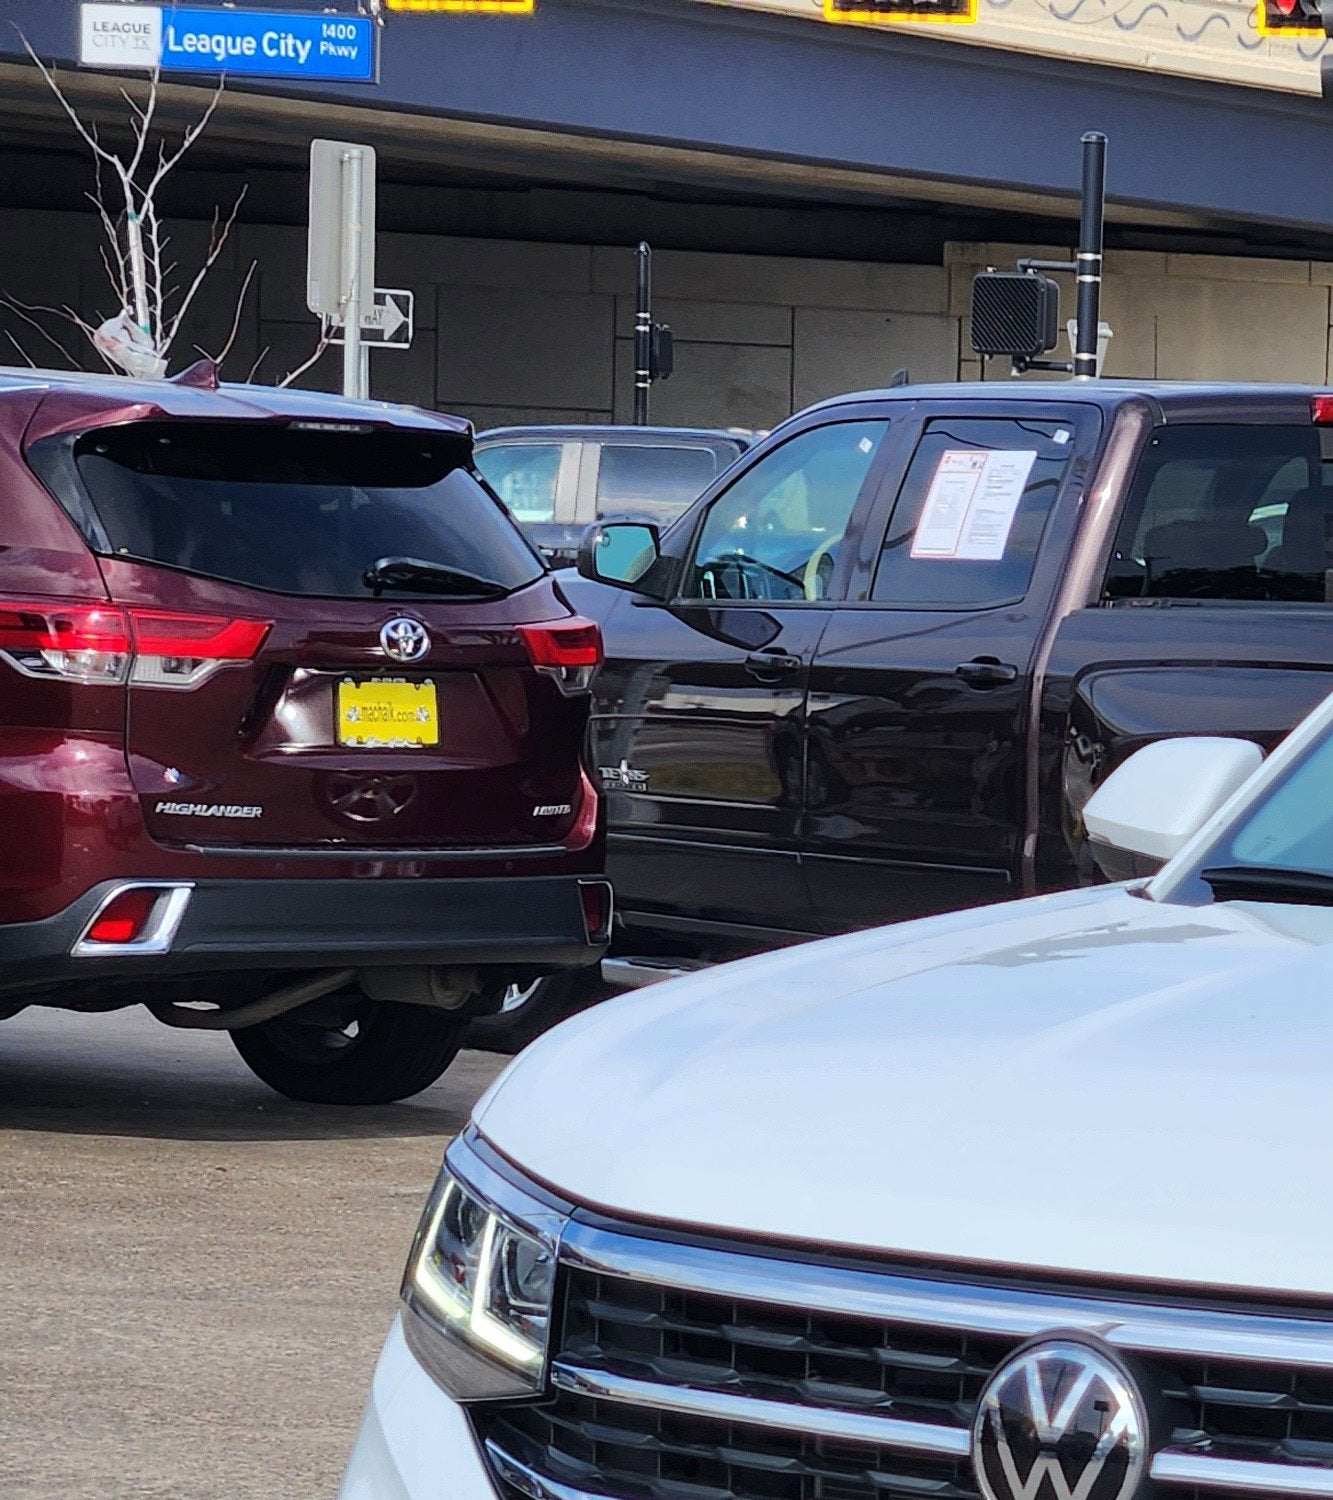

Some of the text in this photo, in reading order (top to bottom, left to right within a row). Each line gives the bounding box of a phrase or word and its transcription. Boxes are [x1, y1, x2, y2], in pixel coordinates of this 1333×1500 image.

[92, 21, 151, 34] LEAGUE
[322, 23, 356, 40] 1400
[93, 34, 128, 48] CITY
[168, 26, 311, 63] League City
[320, 41, 358, 59] Pkwy
[155, 802, 262, 818] HIGHLANDER
